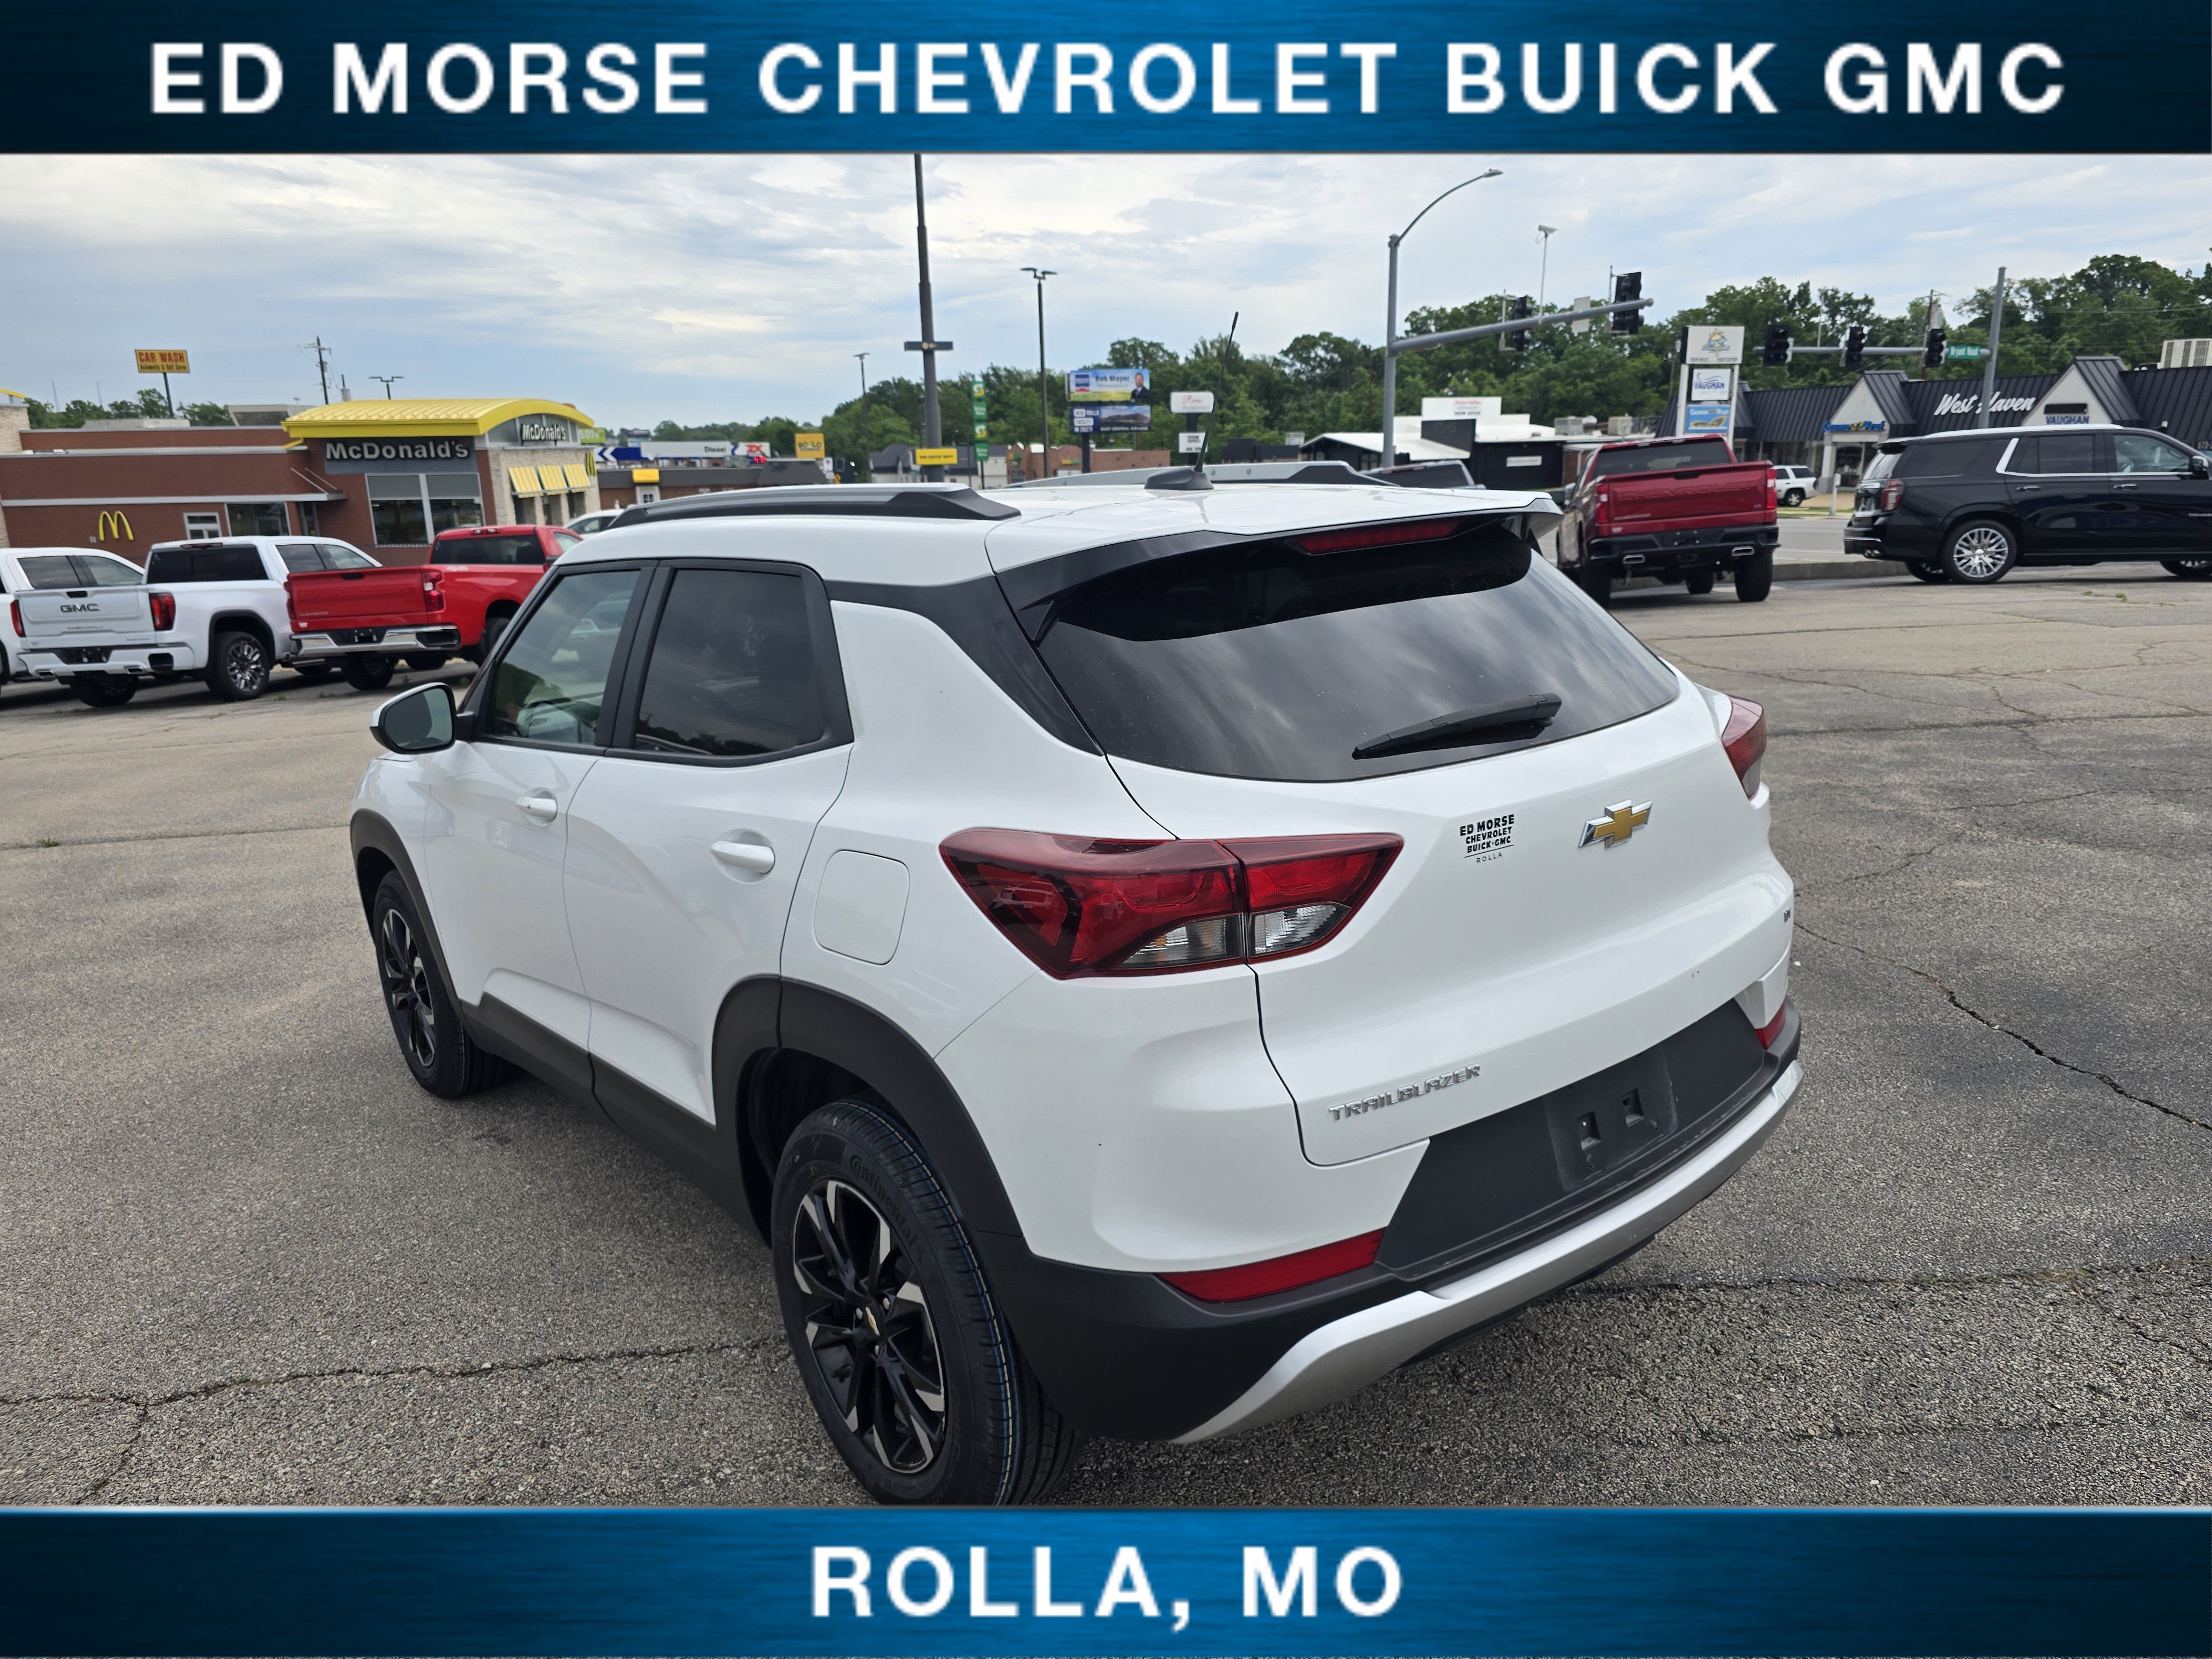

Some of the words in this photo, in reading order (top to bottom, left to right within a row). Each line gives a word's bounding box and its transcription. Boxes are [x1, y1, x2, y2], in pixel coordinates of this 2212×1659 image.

[139, 352, 156, 363] CAR
[159, 352, 185, 363] WASH
[1934, 393, 1979, 415] West
[2046, 415, 2089, 425] VAUGHAN
[520, 423, 566, 441] McDonald's
[325, 440, 469, 461] McDonald's
[61, 603, 100, 613] GMC
[1460, 823, 1474, 837] ED
[1477, 813, 1515, 833] MORSE
[1465, 826, 1512, 844] CHEVROLET
[1477, 852, 1503, 864] ROLLA
[1328, 1063, 1480, 1121] TRAILBLAZER
[849, 1154, 919, 1248] Continental
